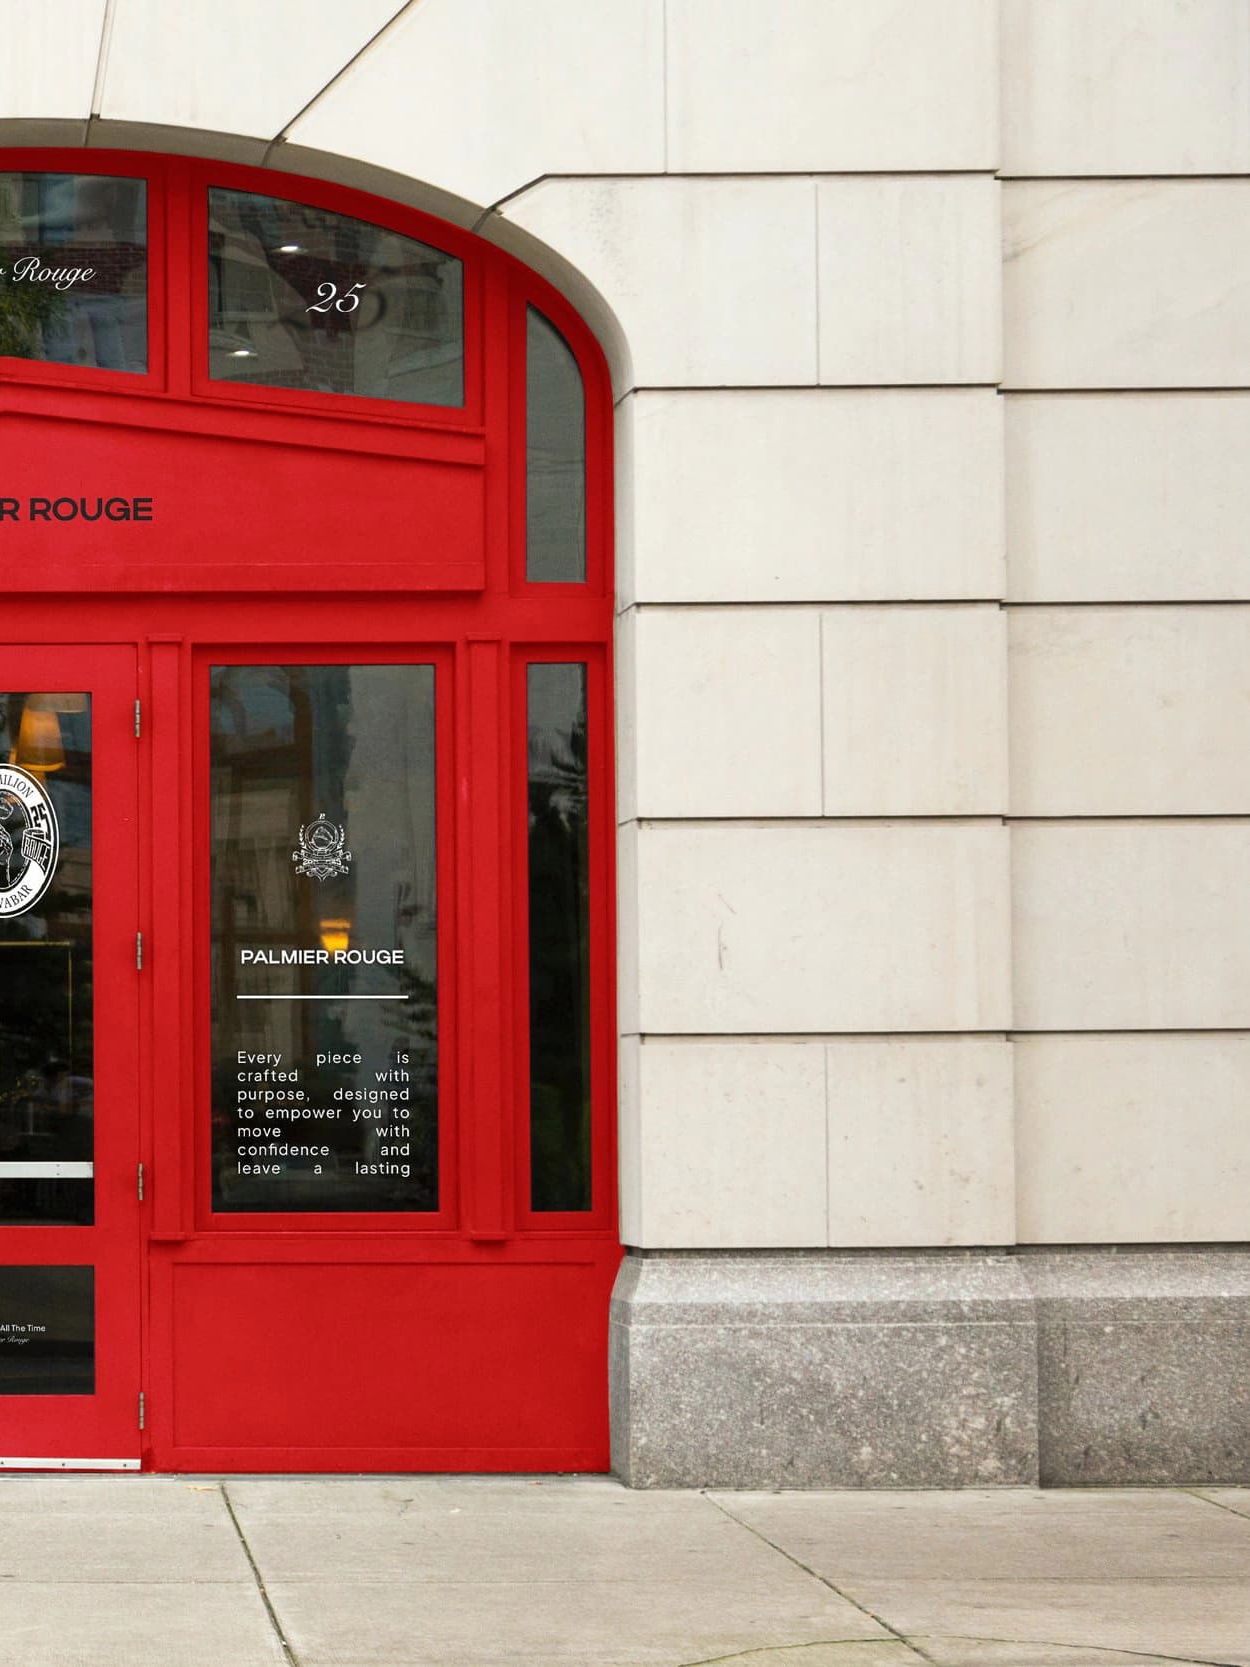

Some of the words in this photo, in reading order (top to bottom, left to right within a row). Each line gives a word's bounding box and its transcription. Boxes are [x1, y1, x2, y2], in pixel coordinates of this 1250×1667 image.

[12, 256, 96, 291] Rouge
[305, 282, 367, 313] 25
[29, 497, 153, 522] ROUGE
[30, 803, 52, 842] 25
[24, 837, 50, 872] ROUGE
[240, 949, 329, 965] PALMIER
[334, 949, 405, 965] ROUGE
[237, 1050, 282, 1068] Every
[316, 1050, 363, 1067] piece
[396, 1050, 410, 1064] is
[237, 1068, 299, 1082] crafted
[374, 1068, 410, 1082] with
[237, 1090, 311, 1104] purpose,
[333, 1087, 410, 1104] designed
[237, 1107, 255, 1120] to
[265, 1108, 343, 1122] empower
[352, 1108, 382, 1122] you
[392, 1107, 410, 1120] to
[237, 1127, 282, 1138] move
[375, 1124, 410, 1138] with
[237, 1142, 330, 1156] confidence
[380, 1142, 410, 1156] and
[237, 1161, 281, 1175] leave
[313, 1164, 323, 1175] a
[354, 1161, 411, 1178] lasting
[0, 1324, 10, 1332] All
[11, 1324, 26, 1332] The
[27, 1324, 46, 1332] Time
